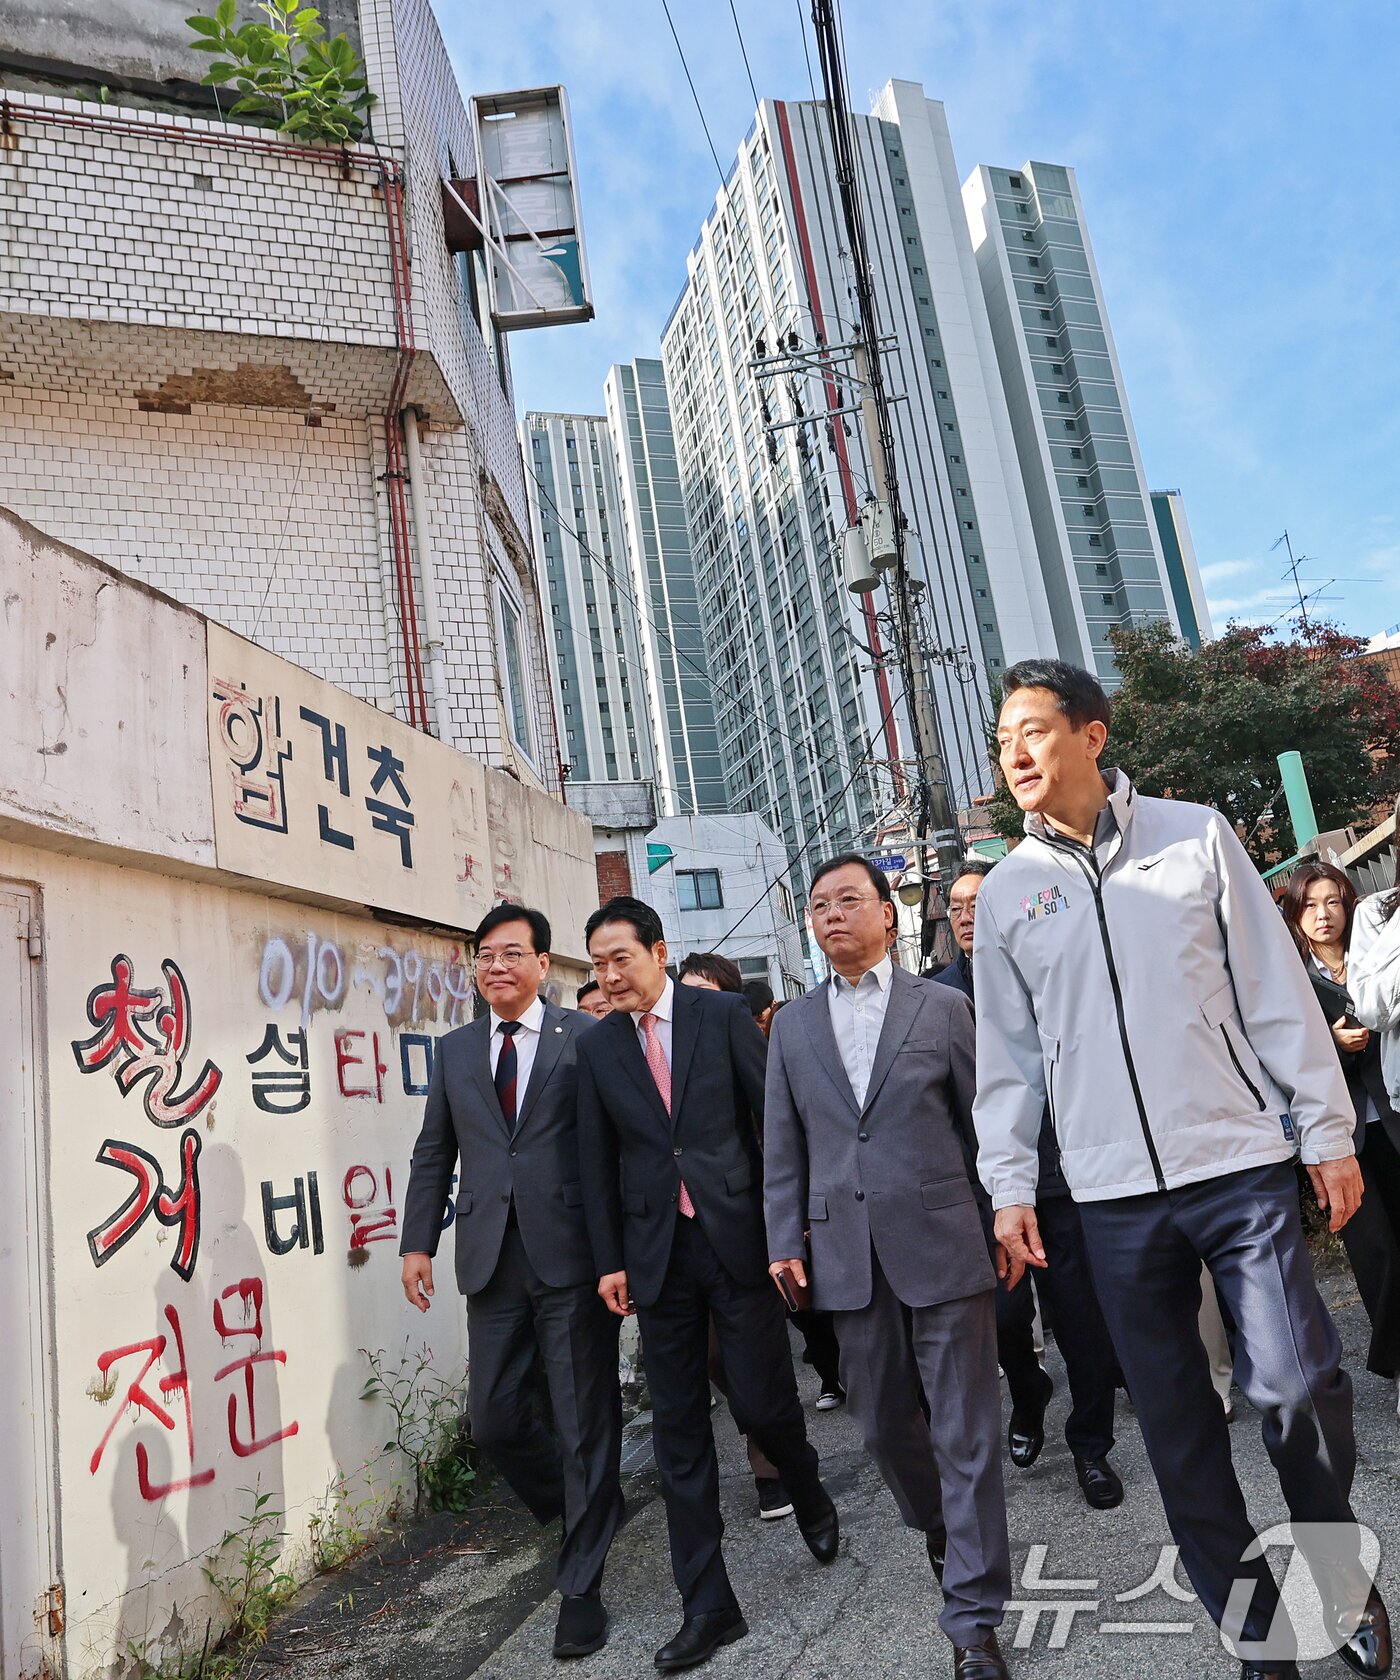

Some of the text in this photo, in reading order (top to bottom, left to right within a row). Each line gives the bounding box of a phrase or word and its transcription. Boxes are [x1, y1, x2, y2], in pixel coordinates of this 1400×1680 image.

[245, 1023, 324, 1256] 설비
[333, 1029, 398, 1250] 타일
[90, 1277, 298, 1502] 전문
